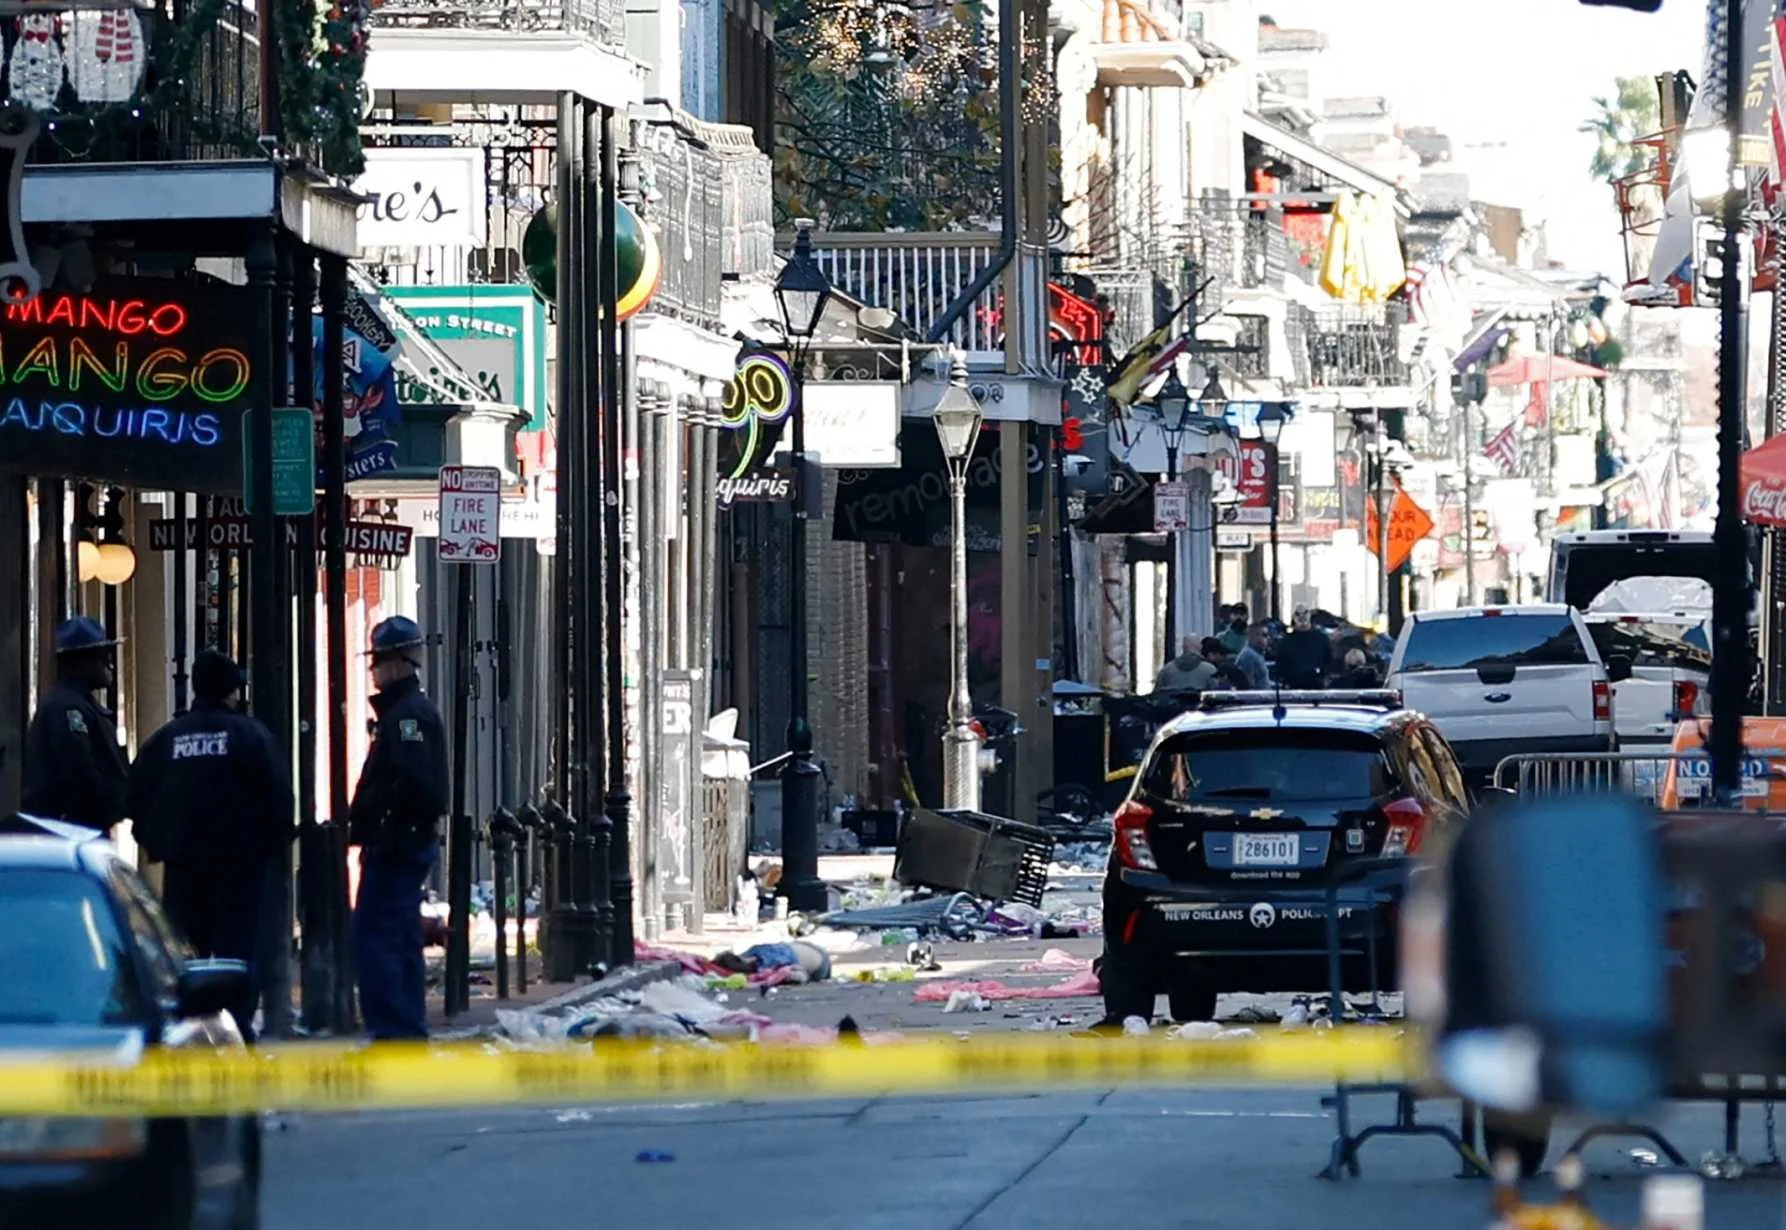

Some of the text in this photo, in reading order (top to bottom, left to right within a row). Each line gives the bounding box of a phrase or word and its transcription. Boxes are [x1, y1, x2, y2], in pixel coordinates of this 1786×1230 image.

[357, 181, 458, 223] re's
[0, 334, 250, 402] ANGO
[347, 452, 386, 480] sters
[442, 470, 461, 488] NO
[454, 497, 486, 514] FIRE
[451, 520, 487, 534] LANE
[173, 739, 228, 760] POLICE
[1245, 841, 1294, 858] 286101
[1165, 910, 1190, 921] NEW
[1192, 909, 1244, 921] ORLEANS
